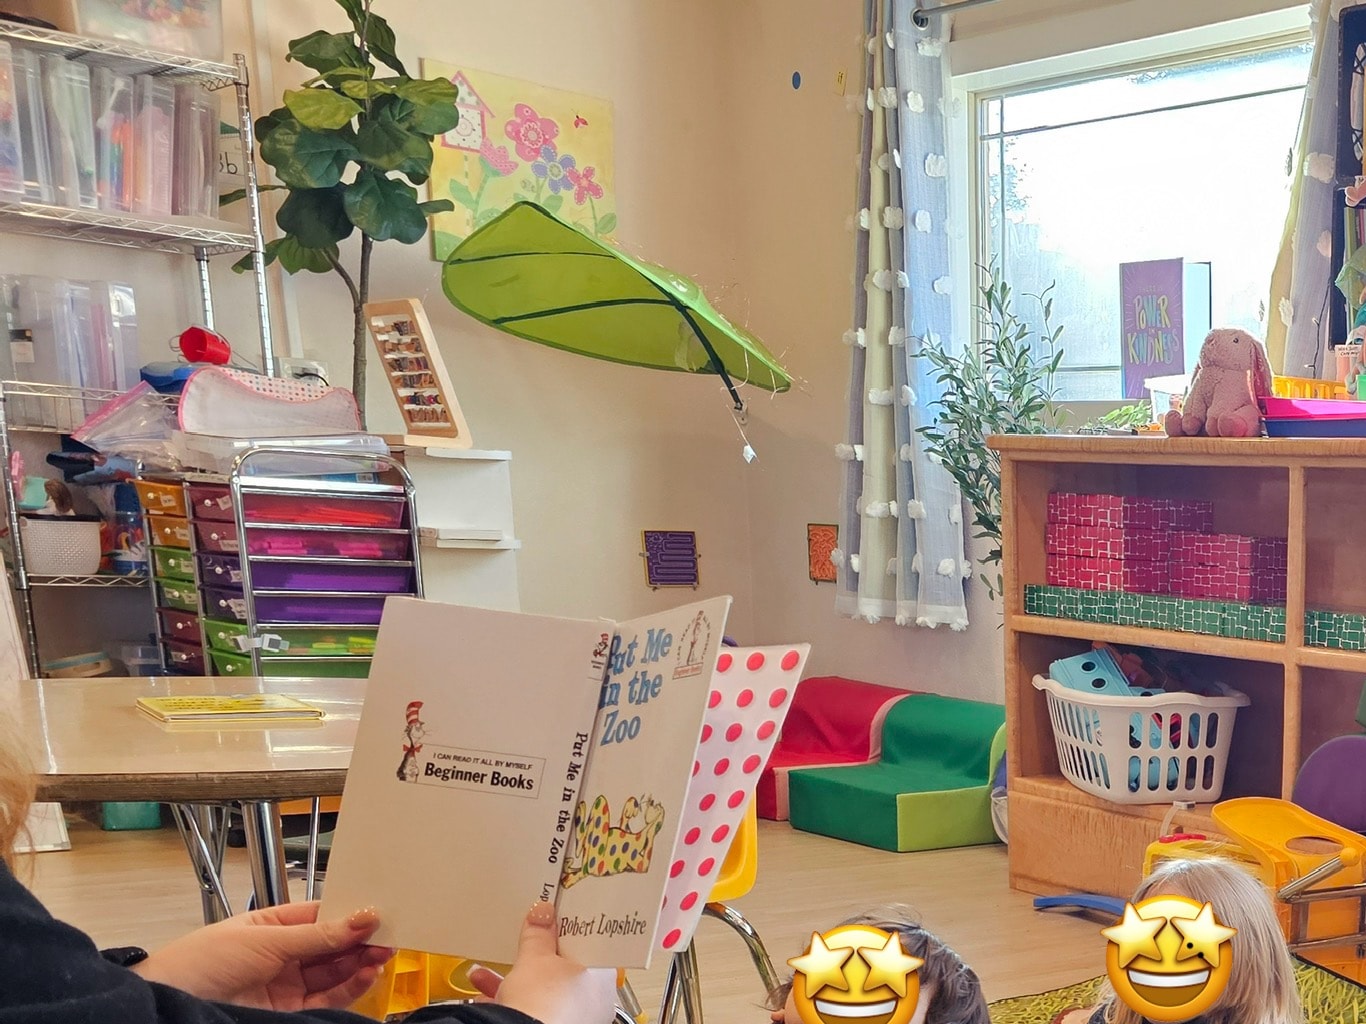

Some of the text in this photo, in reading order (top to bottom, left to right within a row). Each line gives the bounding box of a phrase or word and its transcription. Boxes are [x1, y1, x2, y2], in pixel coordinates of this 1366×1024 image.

[1134, 294, 1171, 330] POWER
[1127, 328, 1180, 366] KINDNESS
[607, 634, 639, 676] Put
[640, 628, 673, 663] Me
[598, 670, 663, 710] in the
[600, 709, 641, 746] Zoo
[424, 762, 535, 790] Beginner Books
[437, 753, 452, 761] CAN
[452, 754, 472, 763] READ
[473, 757, 481, 765] IT
[480, 758, 493, 767] ALL
[495, 760, 505, 768] BY
[505, 761, 534, 770] MYSELF
[548, 732, 589, 864] Put Me in the Zoo
[559, 911, 647, 938] Robert Lopshire
